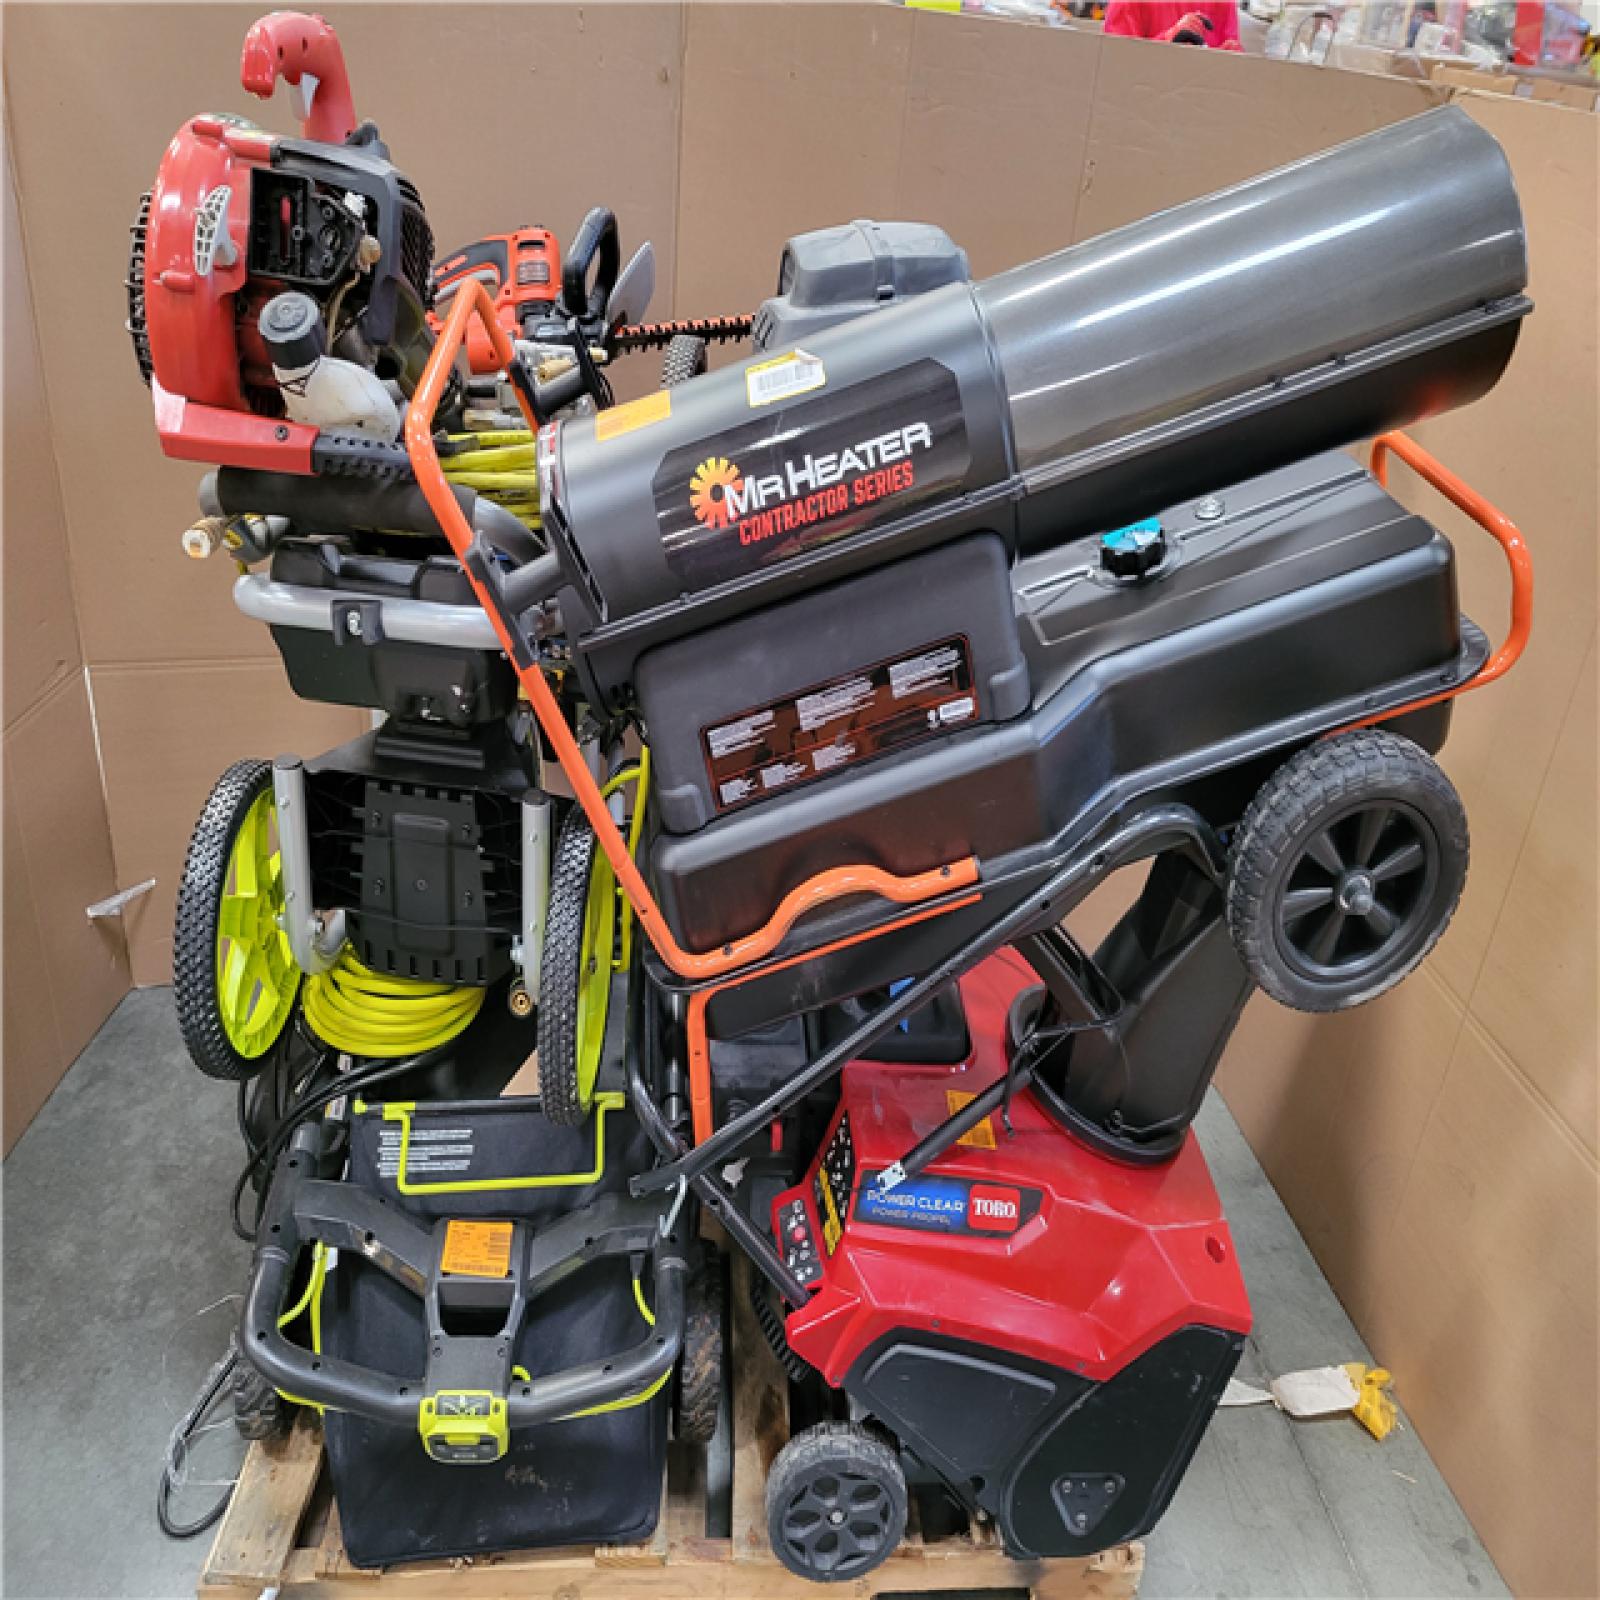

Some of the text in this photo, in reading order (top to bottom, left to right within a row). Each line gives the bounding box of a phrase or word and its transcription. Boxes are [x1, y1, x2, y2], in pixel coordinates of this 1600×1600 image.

[785, 422, 933, 495] HEATER
[739, 459, 914, 545] CONTRACTOR SERIES
[866, 1189, 964, 1213] POWER CLEAR
[872, 1206, 908, 1219] POWER
[974, 1197, 1017, 1219] TORO
